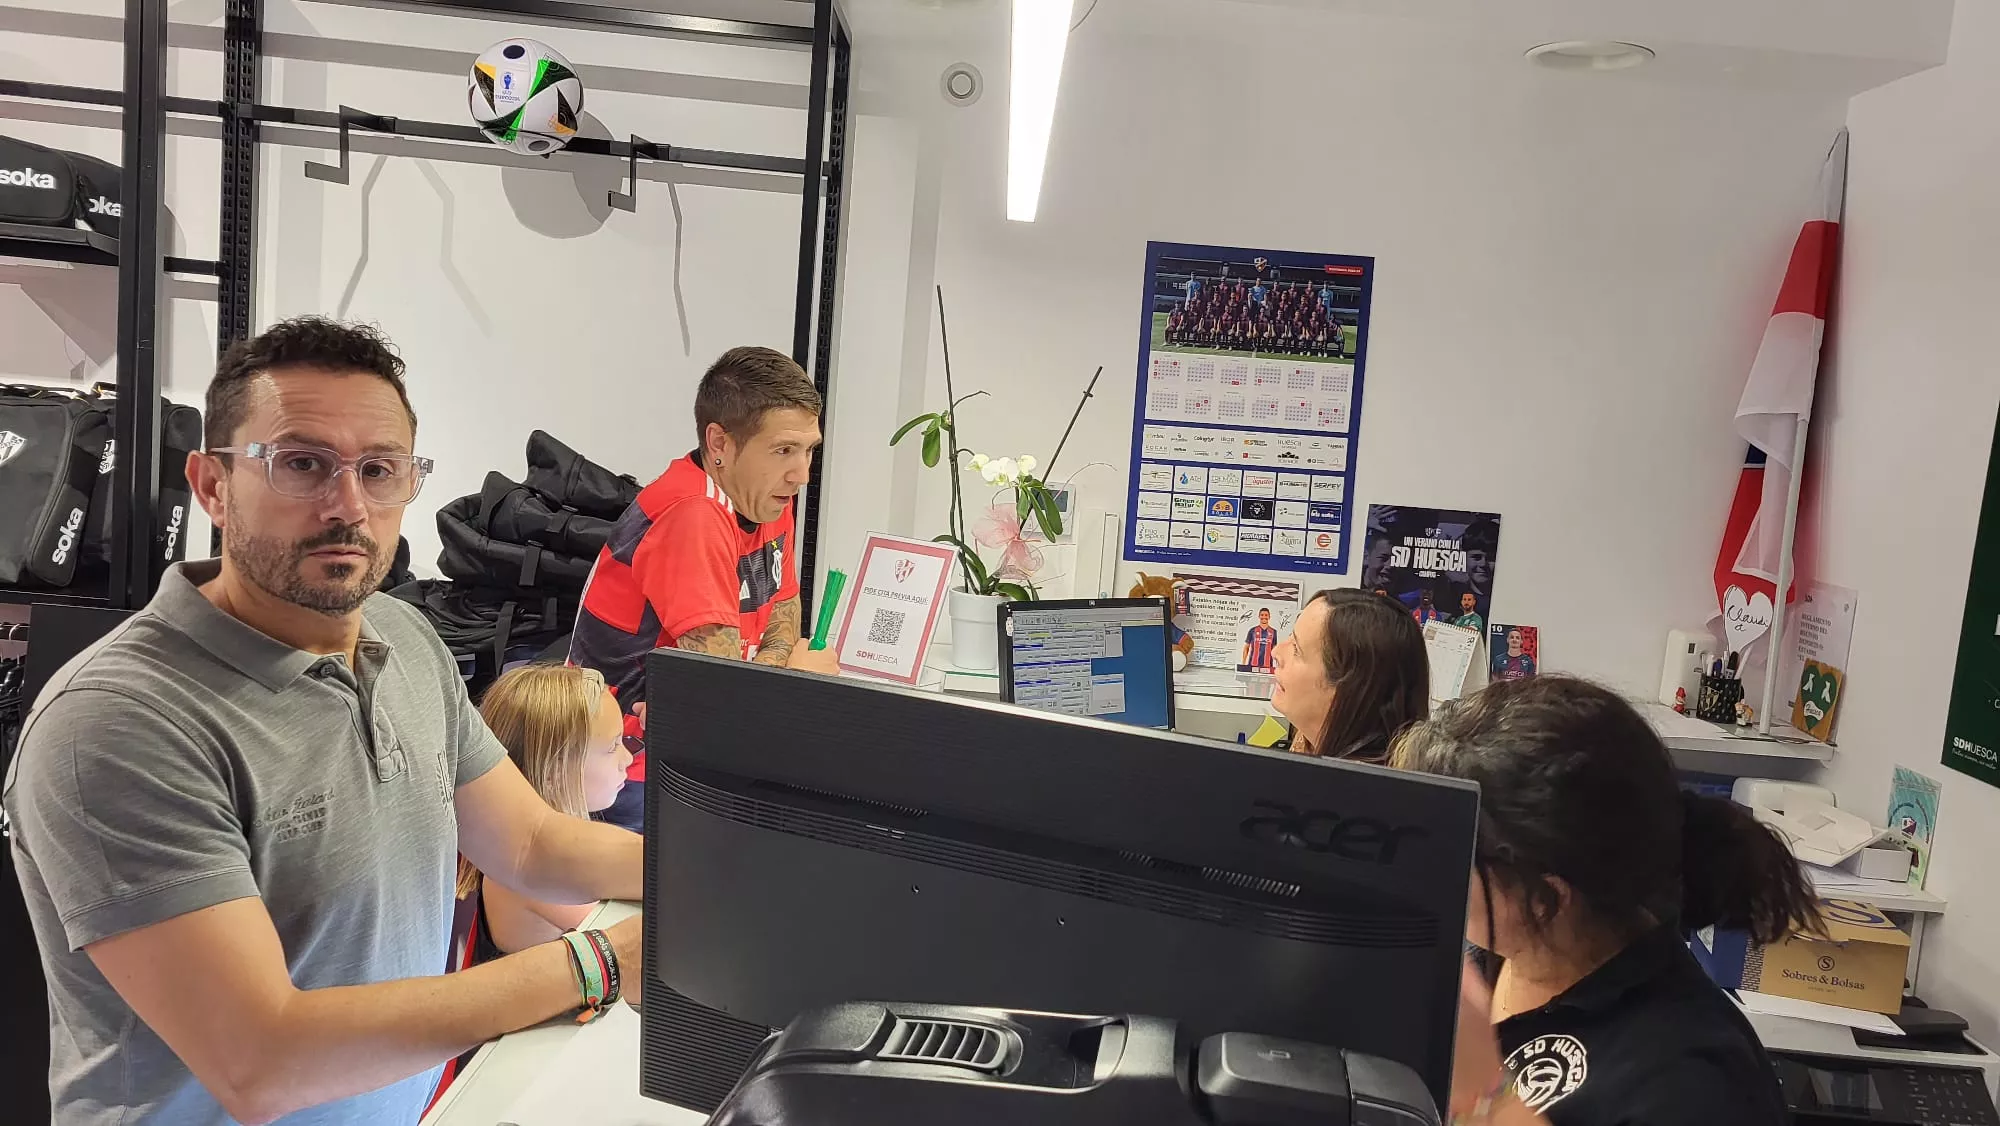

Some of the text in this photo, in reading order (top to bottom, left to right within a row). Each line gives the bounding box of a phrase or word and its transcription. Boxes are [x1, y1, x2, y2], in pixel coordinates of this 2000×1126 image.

[0, 168, 54, 189] soka
[89, 196, 121, 217] oka
[52, 507, 84, 565] soka
[164, 505, 184, 561] soka
[1414, 537, 1438, 549] VERANO
[1438, 539, 1452, 549] CON
[1390, 546, 1467, 572] SD HUESCA
[877, 589, 890, 597] CITA
[890, 591, 911, 601] PREVIA
[1491, 624, 1503, 632] 10
[856, 650, 899, 665] SDHUESCA
[1953, 736, 1998, 763] SDHUESCA
[1238, 798, 1432, 866] acer
[1781, 969, 1818, 984] Sobres
[1818, 975, 1829, 985] &
[1830, 976, 1865, 990] Bolsas
[1523, 1039, 1546, 1059] SD
